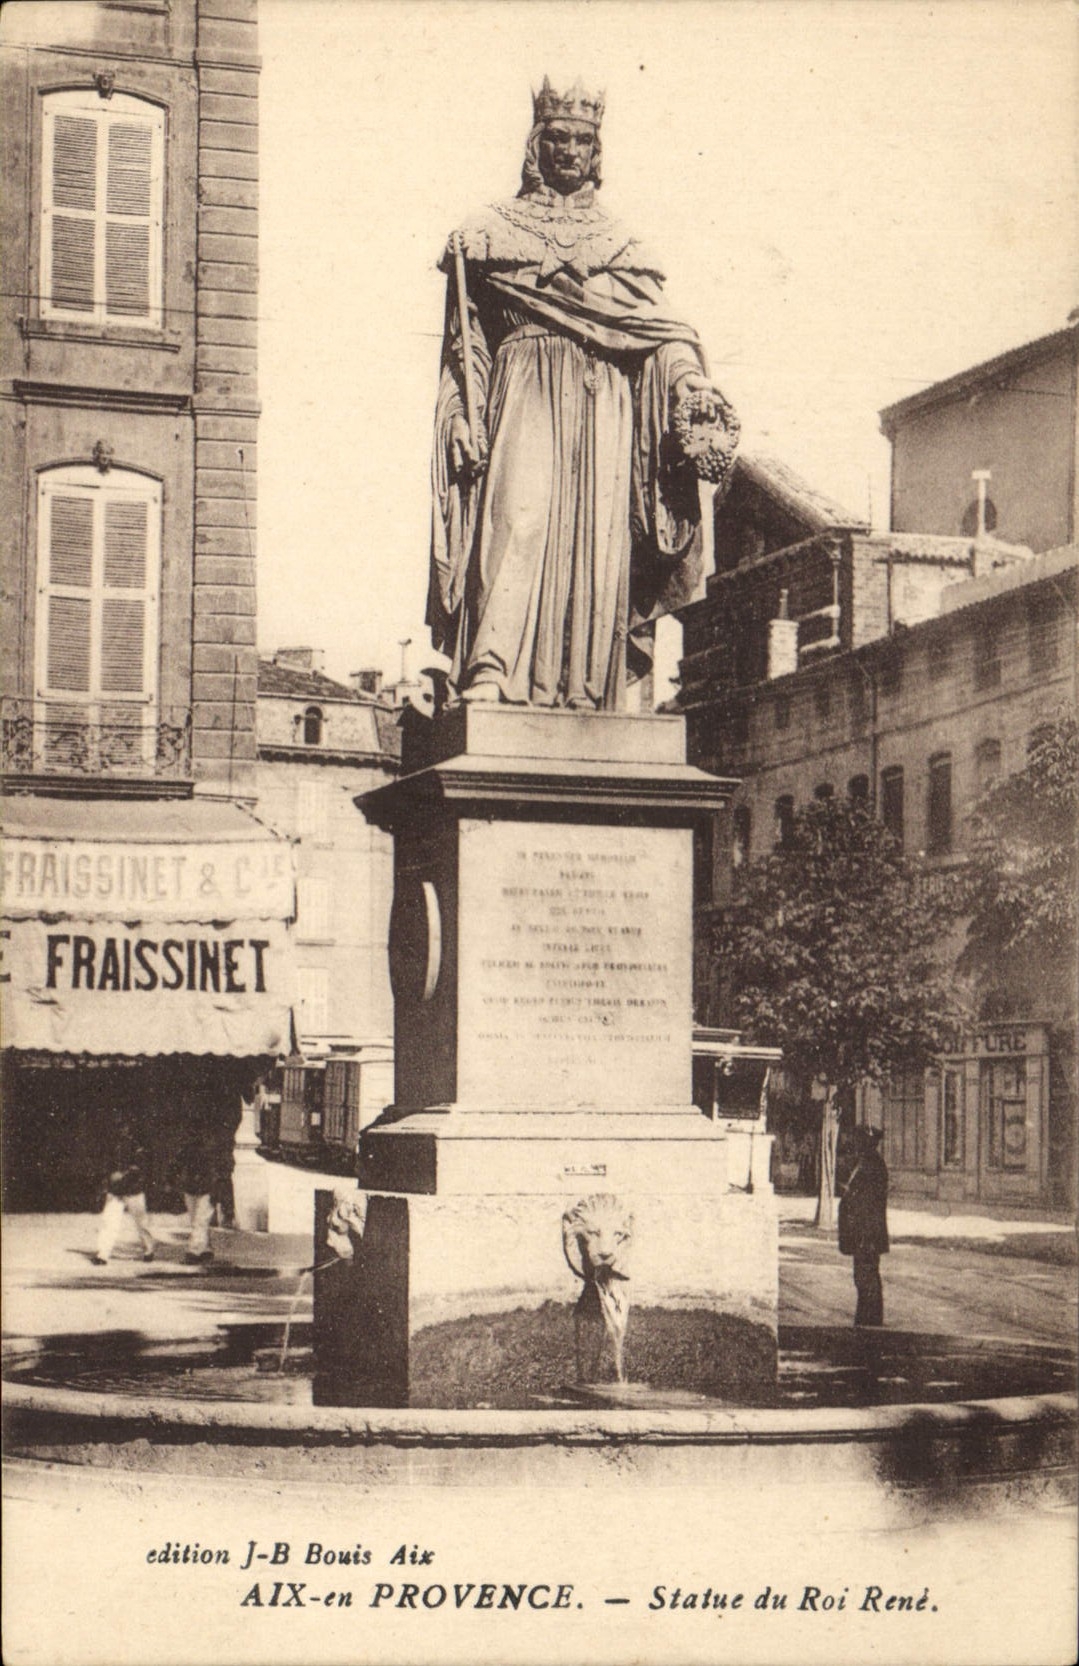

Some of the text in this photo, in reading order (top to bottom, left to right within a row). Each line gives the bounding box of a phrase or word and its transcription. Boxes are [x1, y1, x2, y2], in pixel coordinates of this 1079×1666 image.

[0, 852, 187, 898] FRAISSINET
[200, 862, 222, 896] &
[46, 934, 269, 993] FRAISSINET
